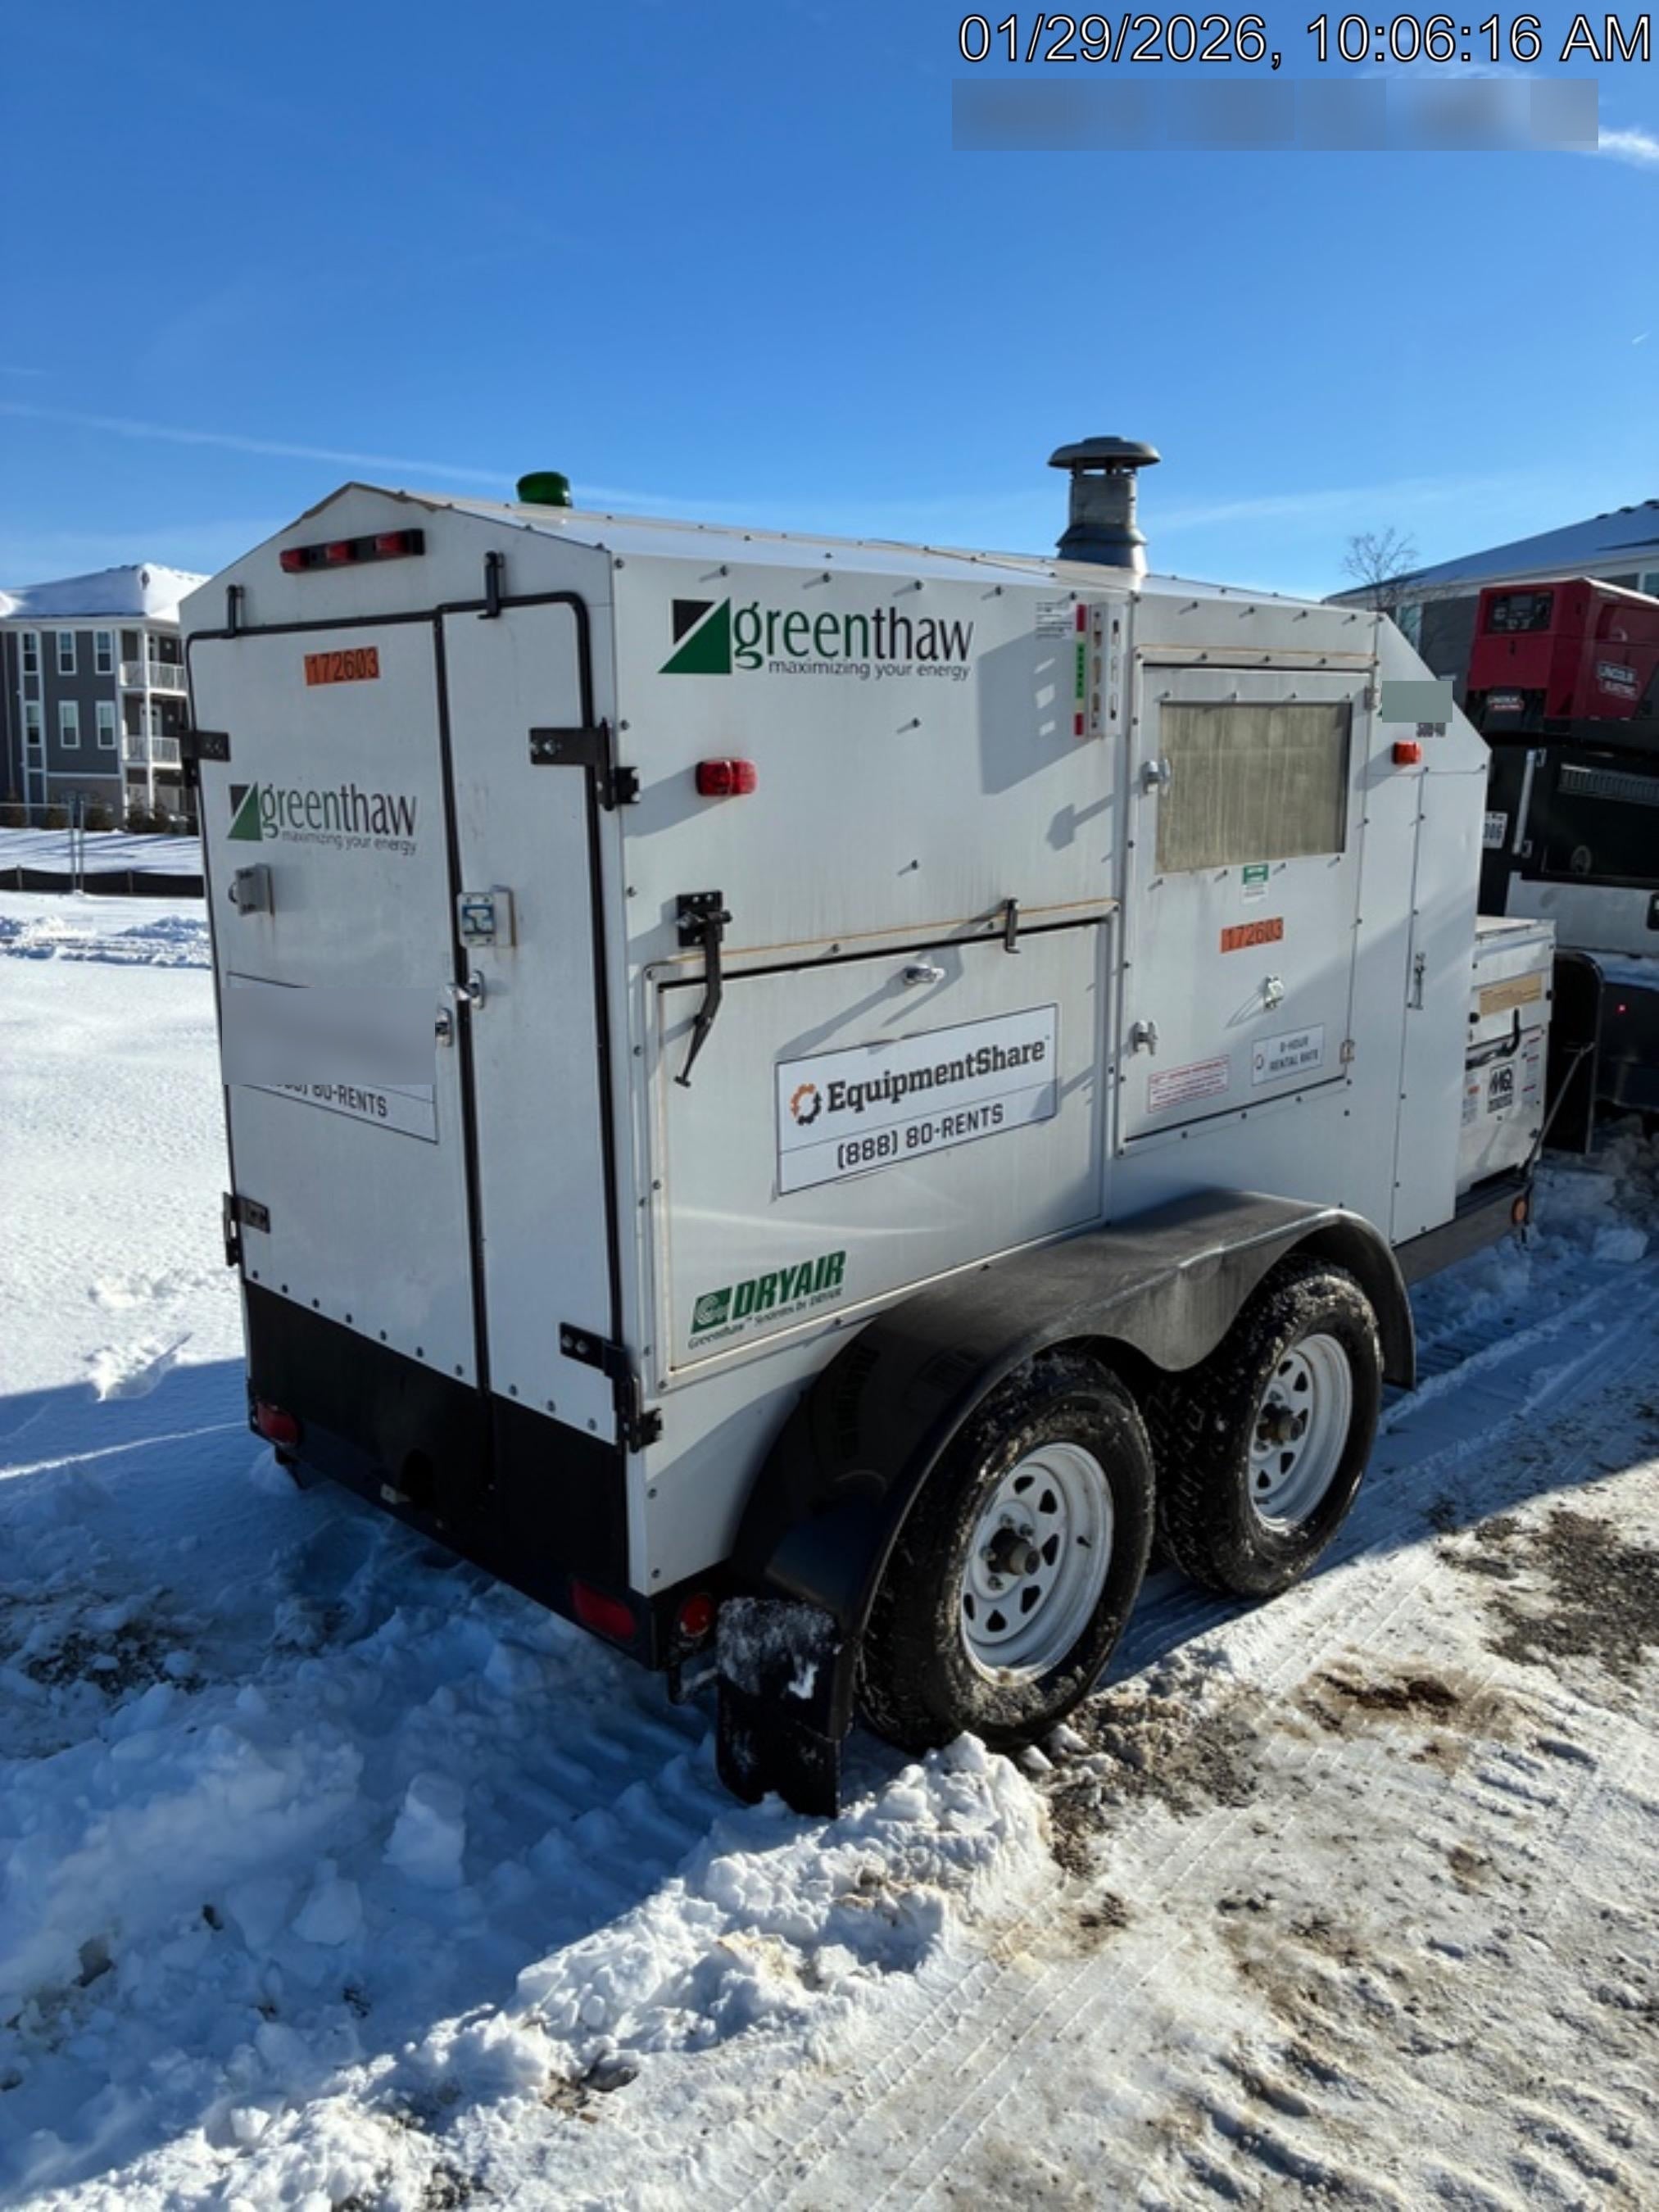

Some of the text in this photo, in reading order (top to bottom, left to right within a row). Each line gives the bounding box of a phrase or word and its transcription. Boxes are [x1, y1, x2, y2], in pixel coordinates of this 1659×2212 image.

[733, 601, 973, 670] greenthaw
[310, 648, 378, 684] 172603
[768, 659, 971, 682] maximizing your energy
[260, 783, 416, 838] greenthaw
[282, 830, 417, 856] maximizing your energy
[827, 1040, 1045, 1114] EquipmentShare
[836, 1104, 1004, 1170] (888) 80-RENTS
[732, 1250, 846, 1321] DRYAIR
